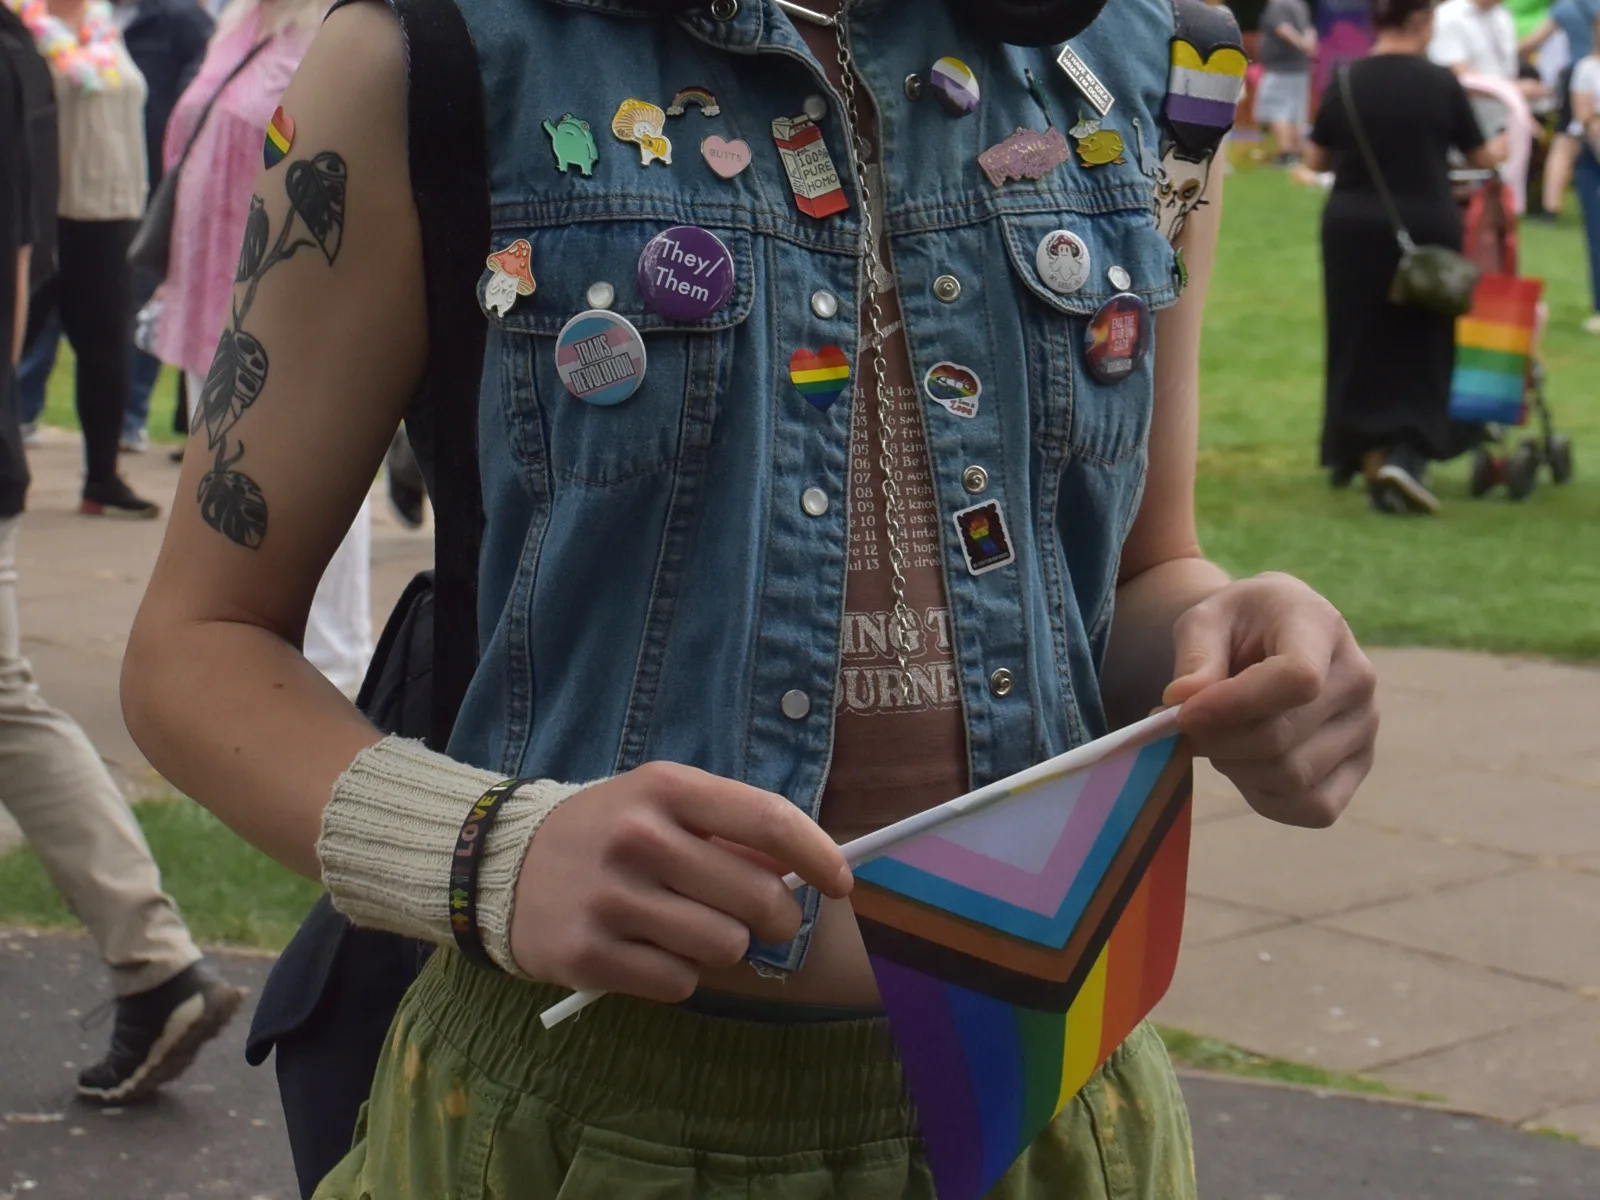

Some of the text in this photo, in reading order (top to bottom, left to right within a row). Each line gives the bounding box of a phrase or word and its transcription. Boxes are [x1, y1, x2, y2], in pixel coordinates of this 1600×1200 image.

[1062, 57, 1080, 77] WHAT
[1087, 86, 1107, 108] DOING
[1070, 56, 1087, 75] HAVE
[1085, 74, 1095, 85] NO
[1094, 84, 1108, 101] IDEA
[710, 149, 742, 162] BUTTS
[799, 148, 829, 167] 100%
[803, 161, 833, 179] PURE
[807, 173, 838, 192] HOMO
[661, 239, 724, 277] They/
[656, 266, 709, 302] Them
[574, 334, 613, 366] TRANS
[569, 352, 635, 394] REVOLUTION
[853, 430, 868, 441] 04
[901, 428, 924, 439] fri
[853, 444, 869, 455] 05
[854, 459, 871, 469] 06
[903, 456, 919, 467] Be
[854, 473, 871, 484] 07
[855, 487, 873, 498] 08
[857, 501, 874, 512] 09
[861, 515, 875, 527] 10
[865, 530, 877, 541] 11
[864, 544, 878, 556] 12
[866, 560, 880, 570] 13
[456, 794, 498, 856] LOVE
